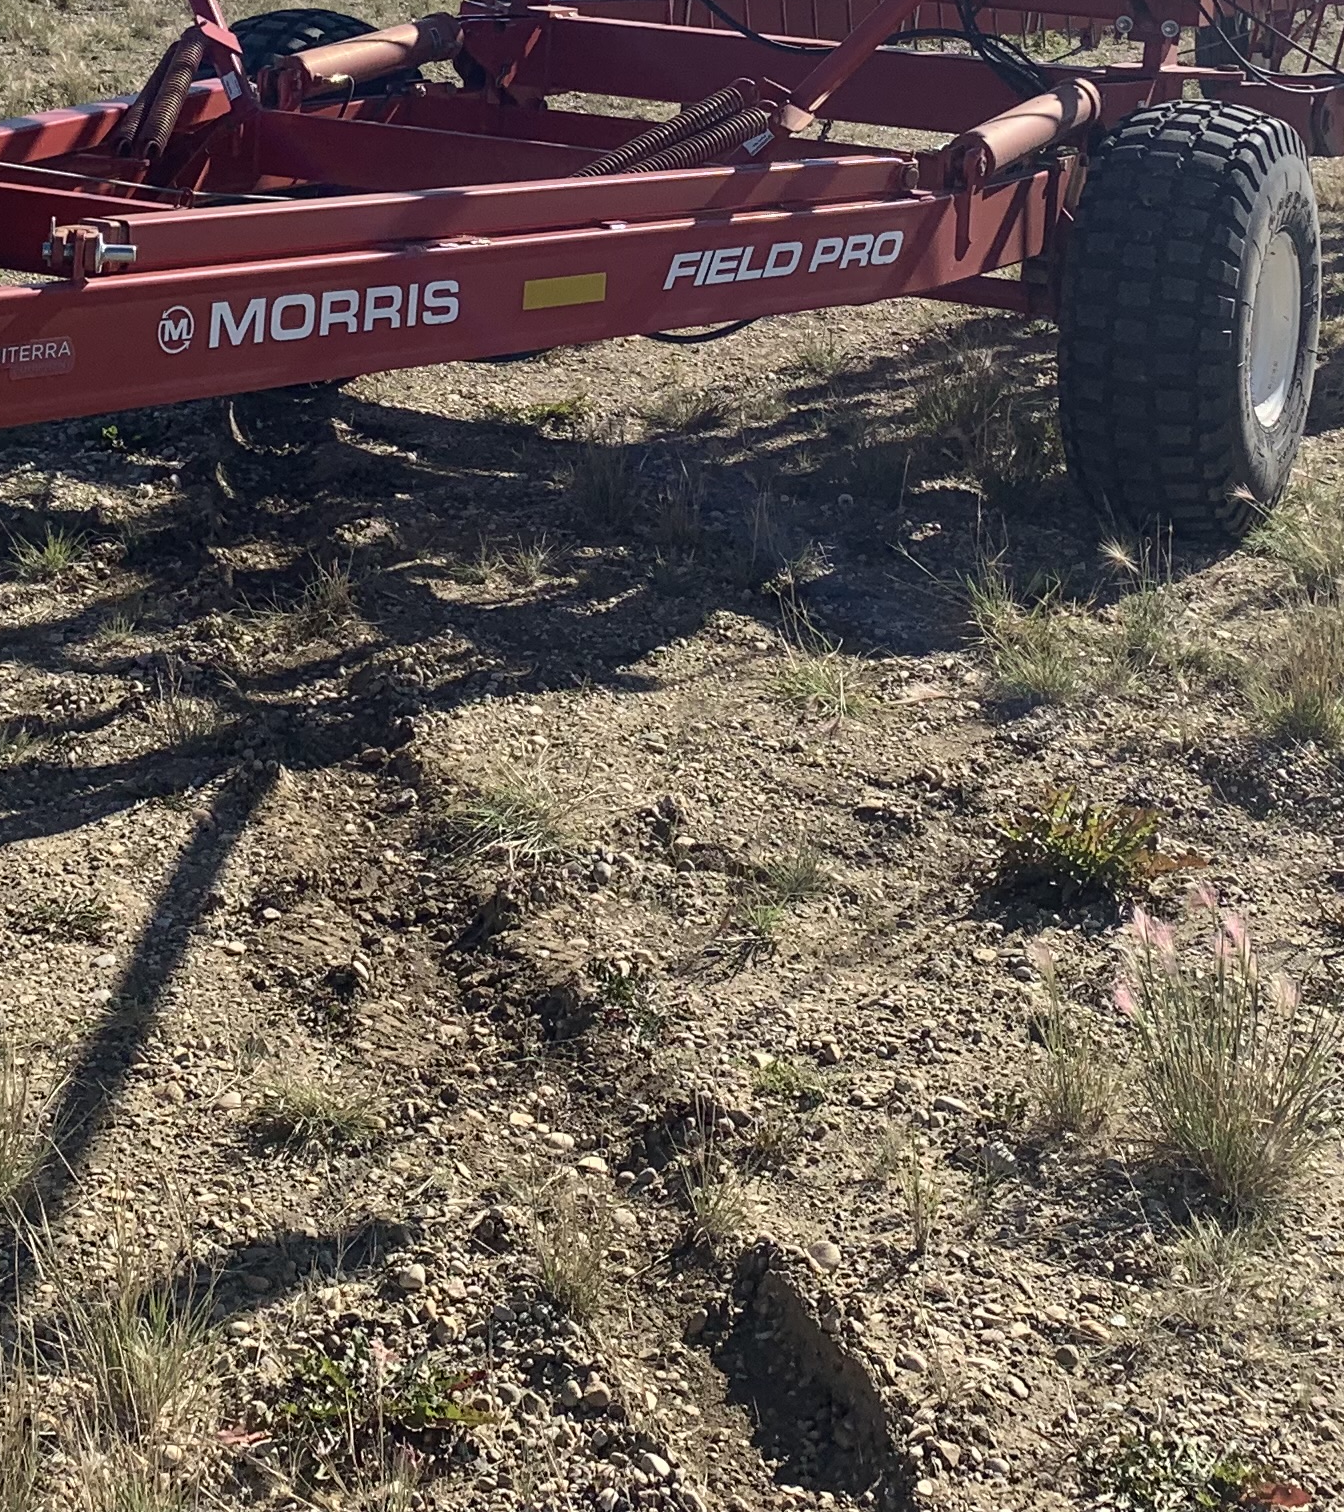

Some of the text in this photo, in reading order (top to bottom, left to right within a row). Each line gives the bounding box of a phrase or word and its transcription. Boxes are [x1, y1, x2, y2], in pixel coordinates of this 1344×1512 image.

[662, 230, 905, 291] FIELD PRO
[162, 280, 460, 349] M MORRIS
